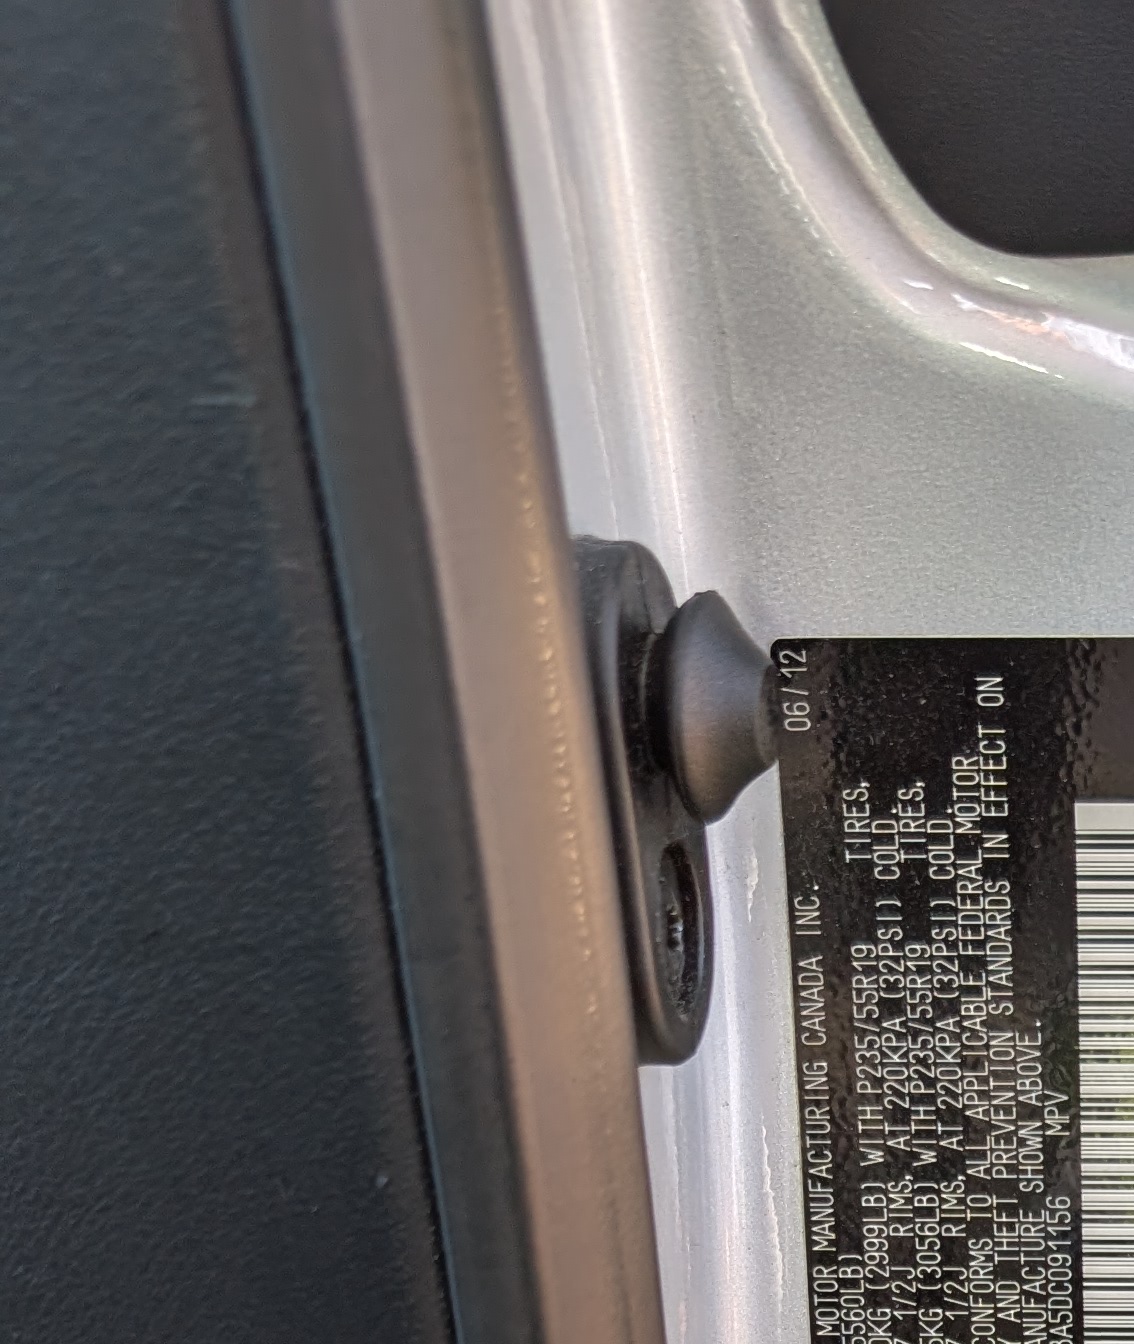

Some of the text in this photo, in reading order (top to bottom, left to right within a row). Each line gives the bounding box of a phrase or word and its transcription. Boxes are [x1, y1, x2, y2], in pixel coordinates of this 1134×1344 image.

[977, 677, 1004, 706] ON
[953, 757, 979, 833] MOTOR
[979, 725, 1007, 816] EFFECT
[843, 782, 871, 862] TIRES,
[873, 809, 900, 879] COLD.
[898, 782, 926, 862] TIRES,
[927, 809, 954, 879] COLD.
[982, 834, 1008, 858] IN
[794, 885, 821, 934] INC.
[956, 850, 983, 954] FEDERAL
[877, 899, 905, 998] (32PSI)
[930, 899, 958, 998] (32PSI)
[984, 882, 1012, 1016] STANDARDS
[798, 956, 826, 1046] CANADA
[851, 945, 881, 1093] P235/55R19
[905, 945, 935, 1093] P235/55R19
[882, 1017, 909, 1108] 220KPA
[935, 1017, 962, 1108] 220KPA
[960, 972, 988, 1120] APPLICABLE
[1016, 1020, 1041, 1106] ABOVE.
[858, 1106, 884, 1165] WITH
[886, 1114, 911, 1150] AT
[912, 1106, 938, 1165] WITH
[939, 1114, 963, 1150] AT
[988, 1032, 1016, 1178] PREVENTION
[1045, 1090, 1070, 1135] MPV
[803, 1063, 836, 1251] MANUFACTURING
[965, 1136, 989, 1179] ALL
[1019, 1121, 1043, 1193] SHOWN
[862, 1184, 890, 1290] (2999LB)
[889, 1175, 914, 1236] RIMS,
[915, 1184, 942, 1290] (3056LB)
[941, 1175, 966, 1236] RIMS,
[967, 1195, 991, 1220] TO
[993, 1197, 1018, 1265] THEFT
[813, 1266, 840, 1335] MOTOR
[996, 1282, 1020, 1322] AND
